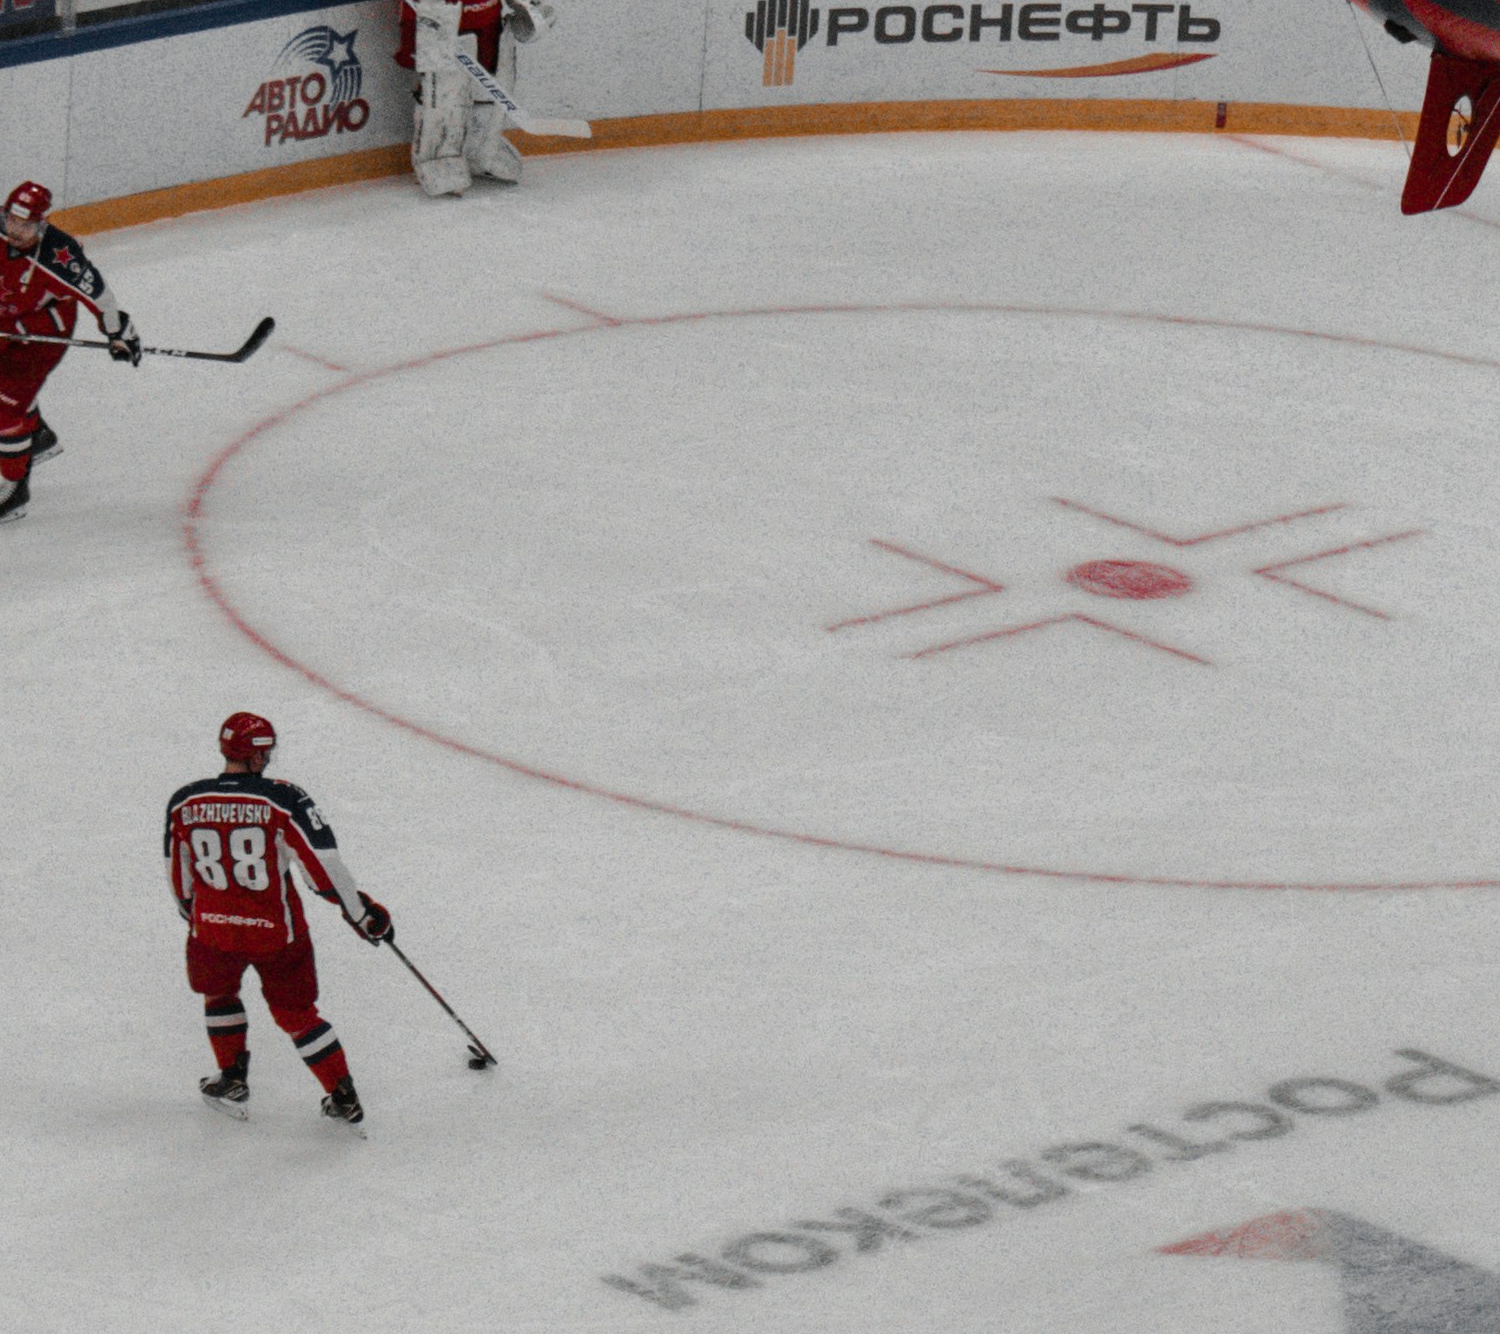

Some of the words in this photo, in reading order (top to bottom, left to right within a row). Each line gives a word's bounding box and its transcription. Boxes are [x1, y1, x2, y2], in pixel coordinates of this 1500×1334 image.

[827, 3, 1221, 47] РОСНЕФТЬ
[242, 70, 326, 118] АВТО
[264, 97, 369, 147] РАДИО
[190, 827, 270, 892] 88
